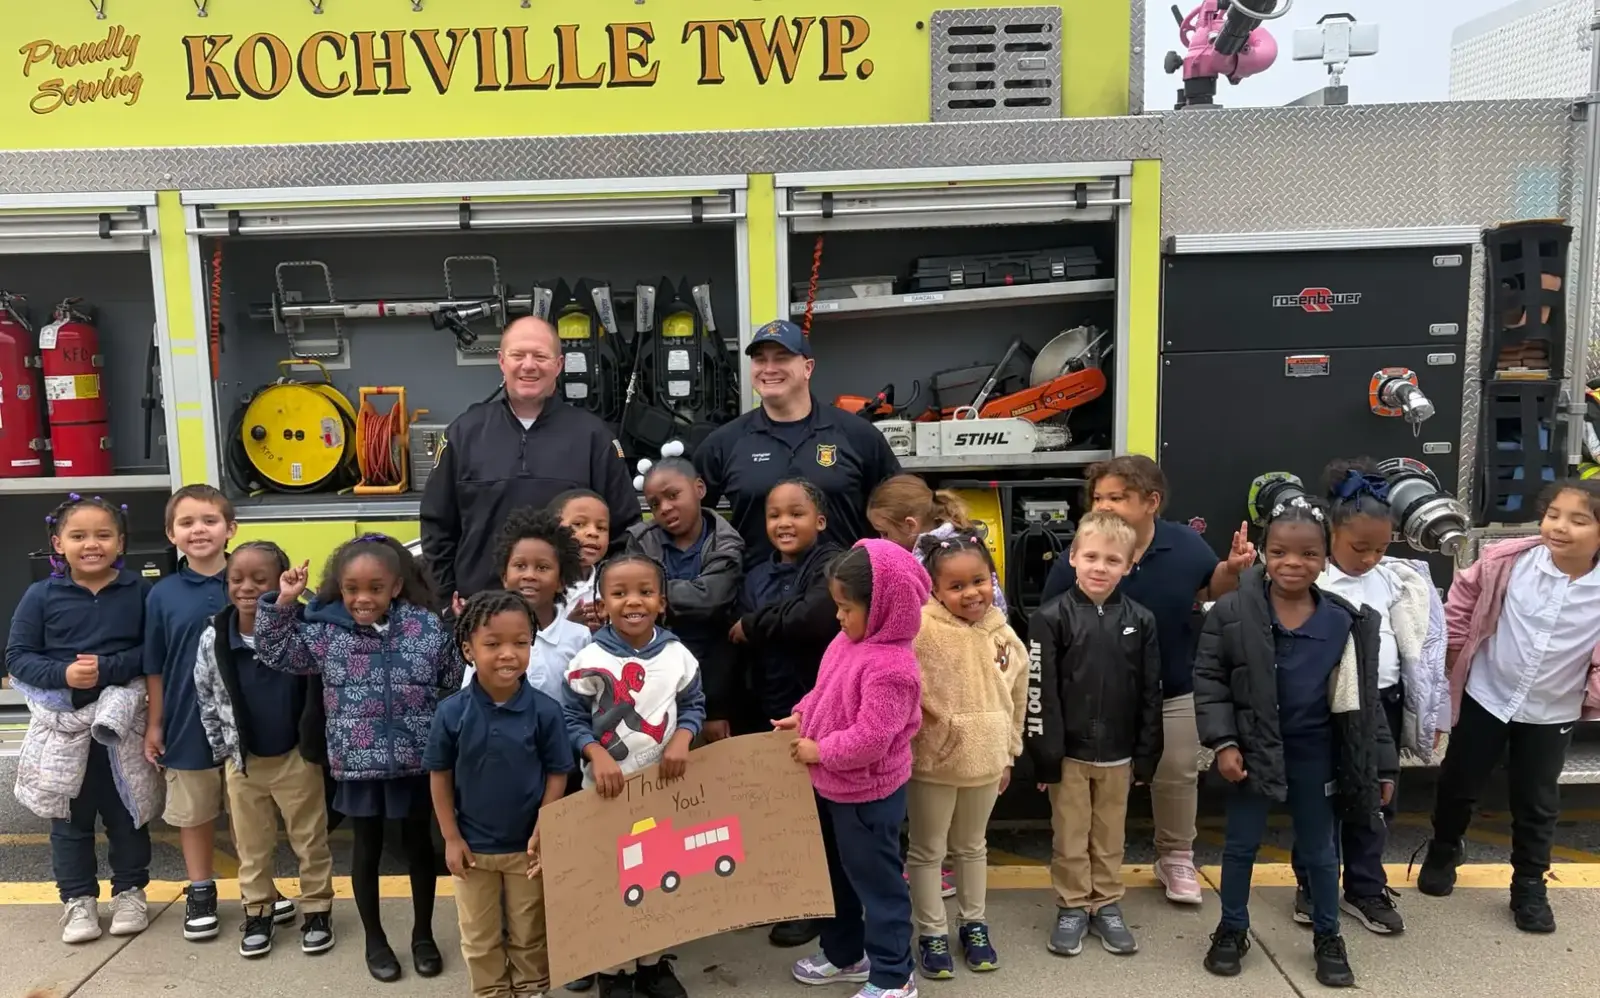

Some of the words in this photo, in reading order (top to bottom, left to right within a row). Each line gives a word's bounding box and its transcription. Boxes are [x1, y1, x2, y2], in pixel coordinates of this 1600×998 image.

[19, 25, 141, 77] Proudly
[182, 22, 660, 100] KOCHVILLE
[681, 15, 874, 85] TWP.
[30, 68, 144, 114] Serving
[1273, 292, 1361, 307] rosenbauer
[954, 432, 1009, 446] STIHL
[1029, 639, 1042, 682] JUST
[1028, 687, 1042, 713] DO
[1027, 717, 1044, 737] IT.
[672, 783, 706, 812] You!
